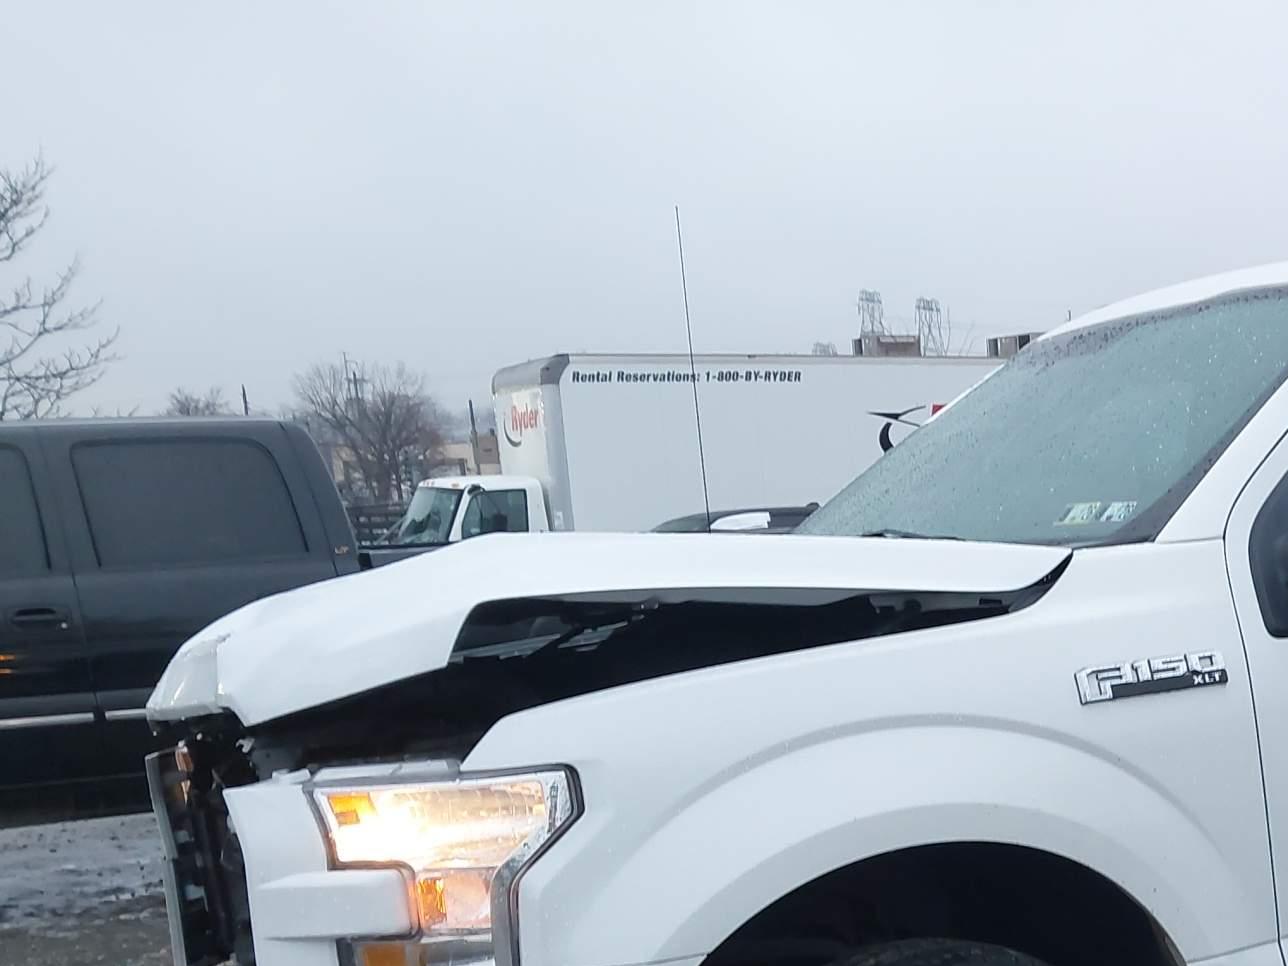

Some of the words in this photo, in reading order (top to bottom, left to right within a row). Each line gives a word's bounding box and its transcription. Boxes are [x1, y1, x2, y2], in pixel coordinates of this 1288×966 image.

[571, 370, 612, 383] Rental
[616, 370, 701, 383] Reservations:
[704, 370, 802, 383] 1-800-BY-RYDER
[511, 402, 539, 437] Ryder
[1191, 671, 1224, 686] XLT
